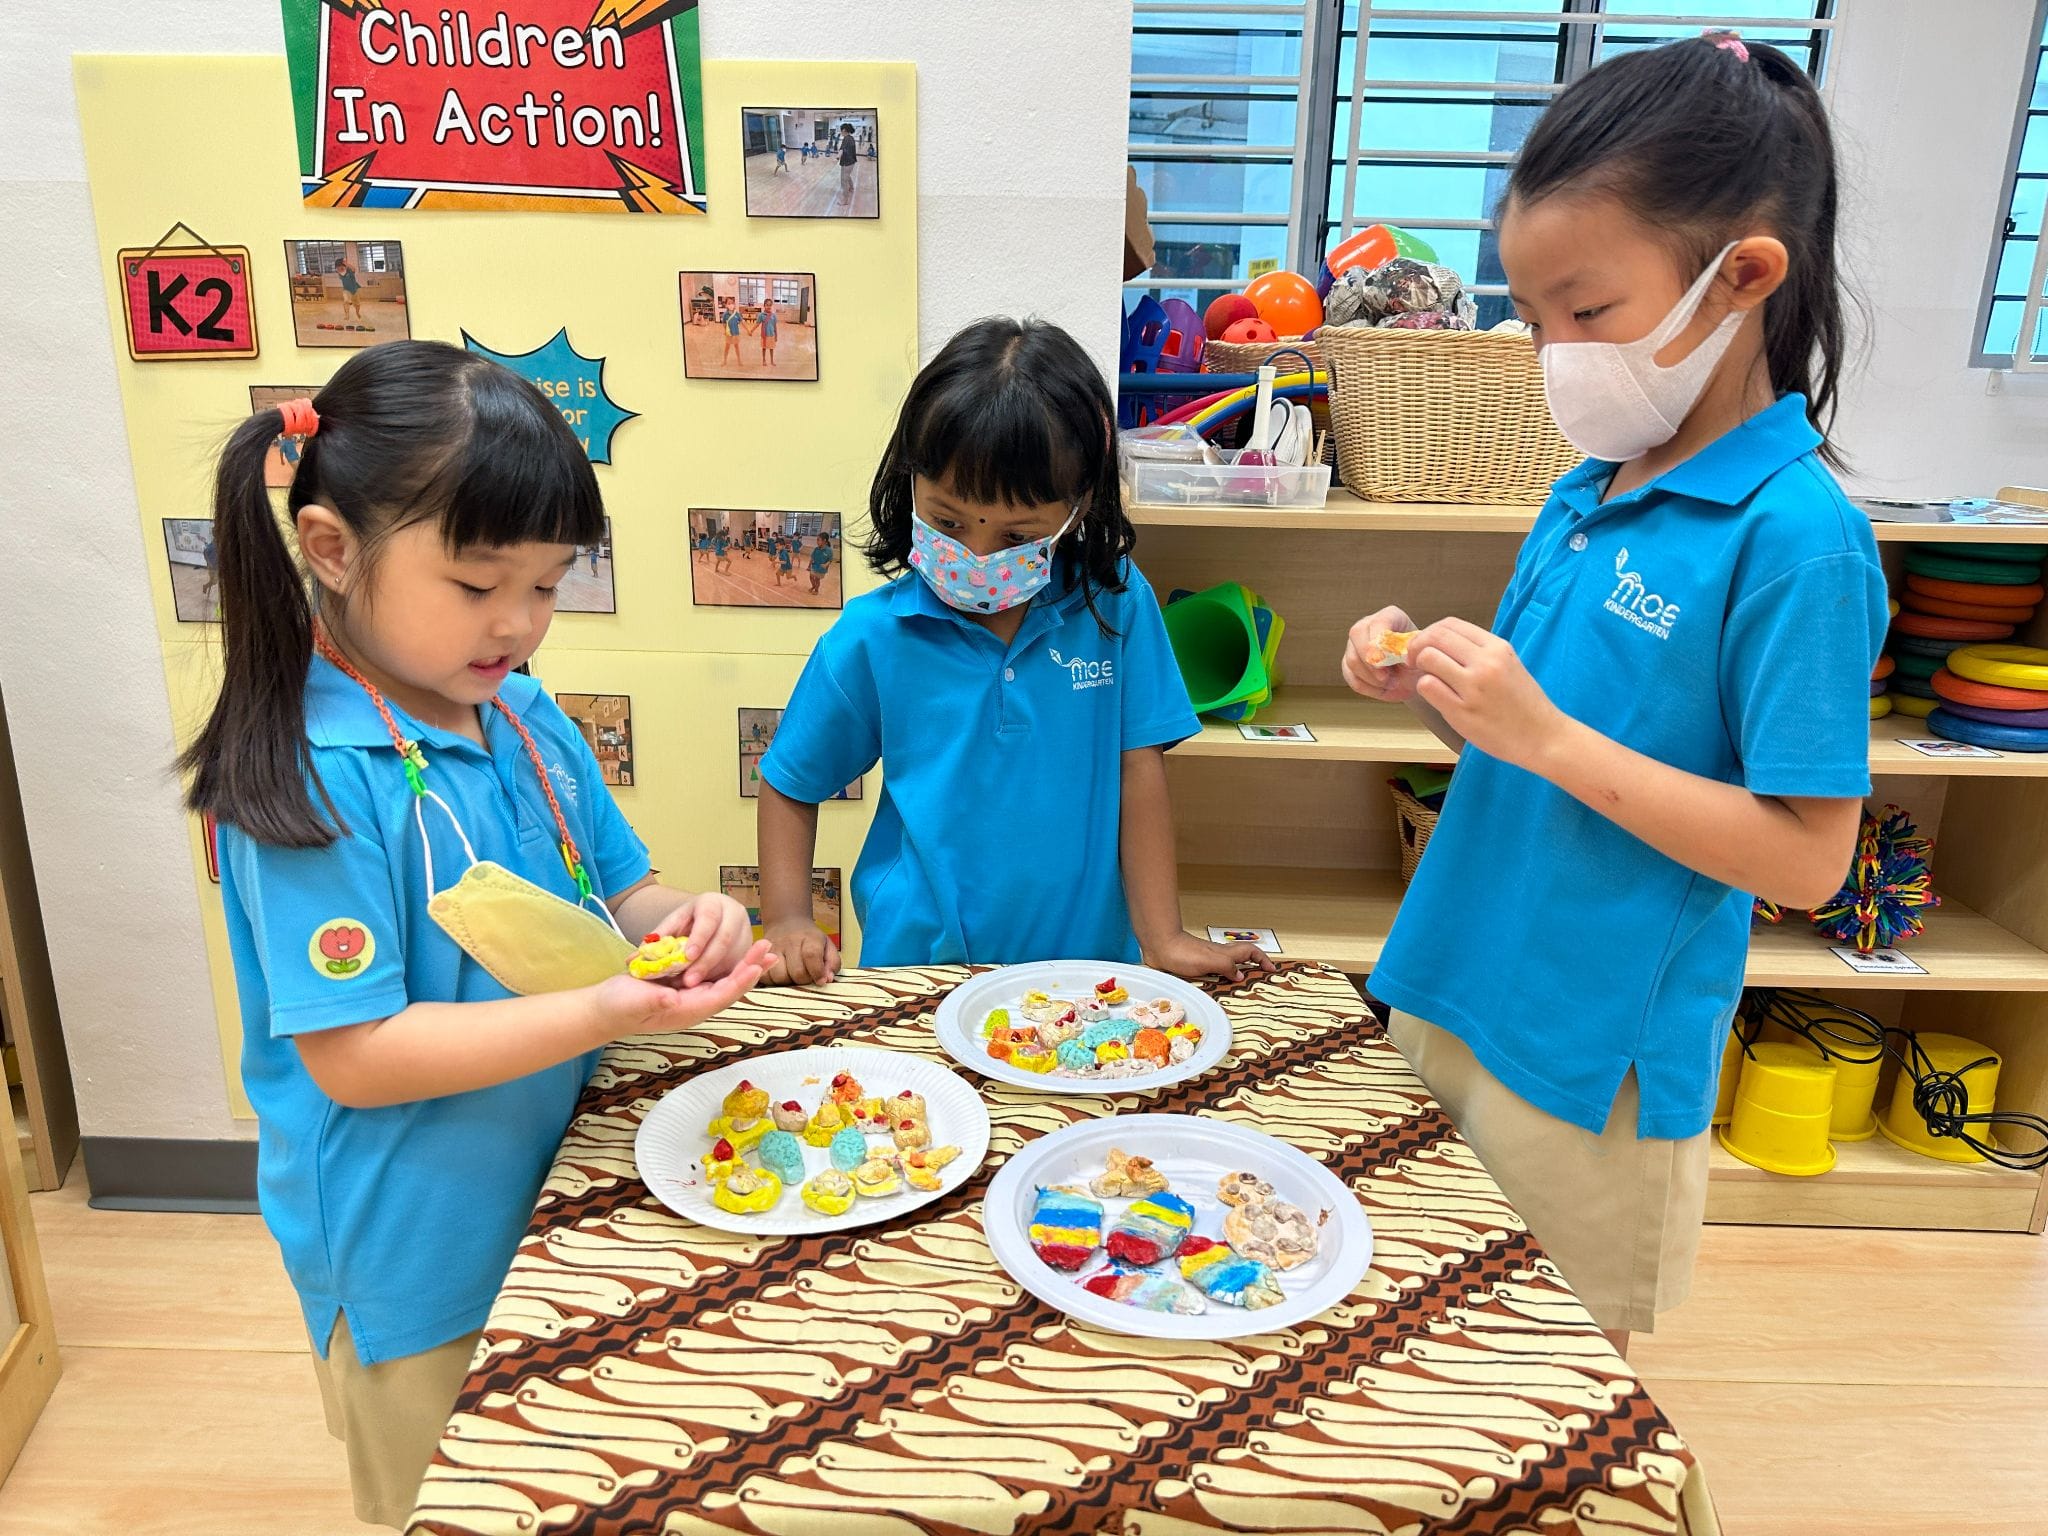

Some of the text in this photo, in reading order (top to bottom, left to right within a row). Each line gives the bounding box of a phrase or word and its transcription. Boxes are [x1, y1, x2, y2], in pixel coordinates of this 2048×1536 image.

[360, 9, 624, 68] Children
[333, 87, 665, 147] In Action!
[147, 270, 235, 343] K2
[533, 377, 597, 398] ise is
[1603, 598, 1670, 640] KINDERGARTEN
